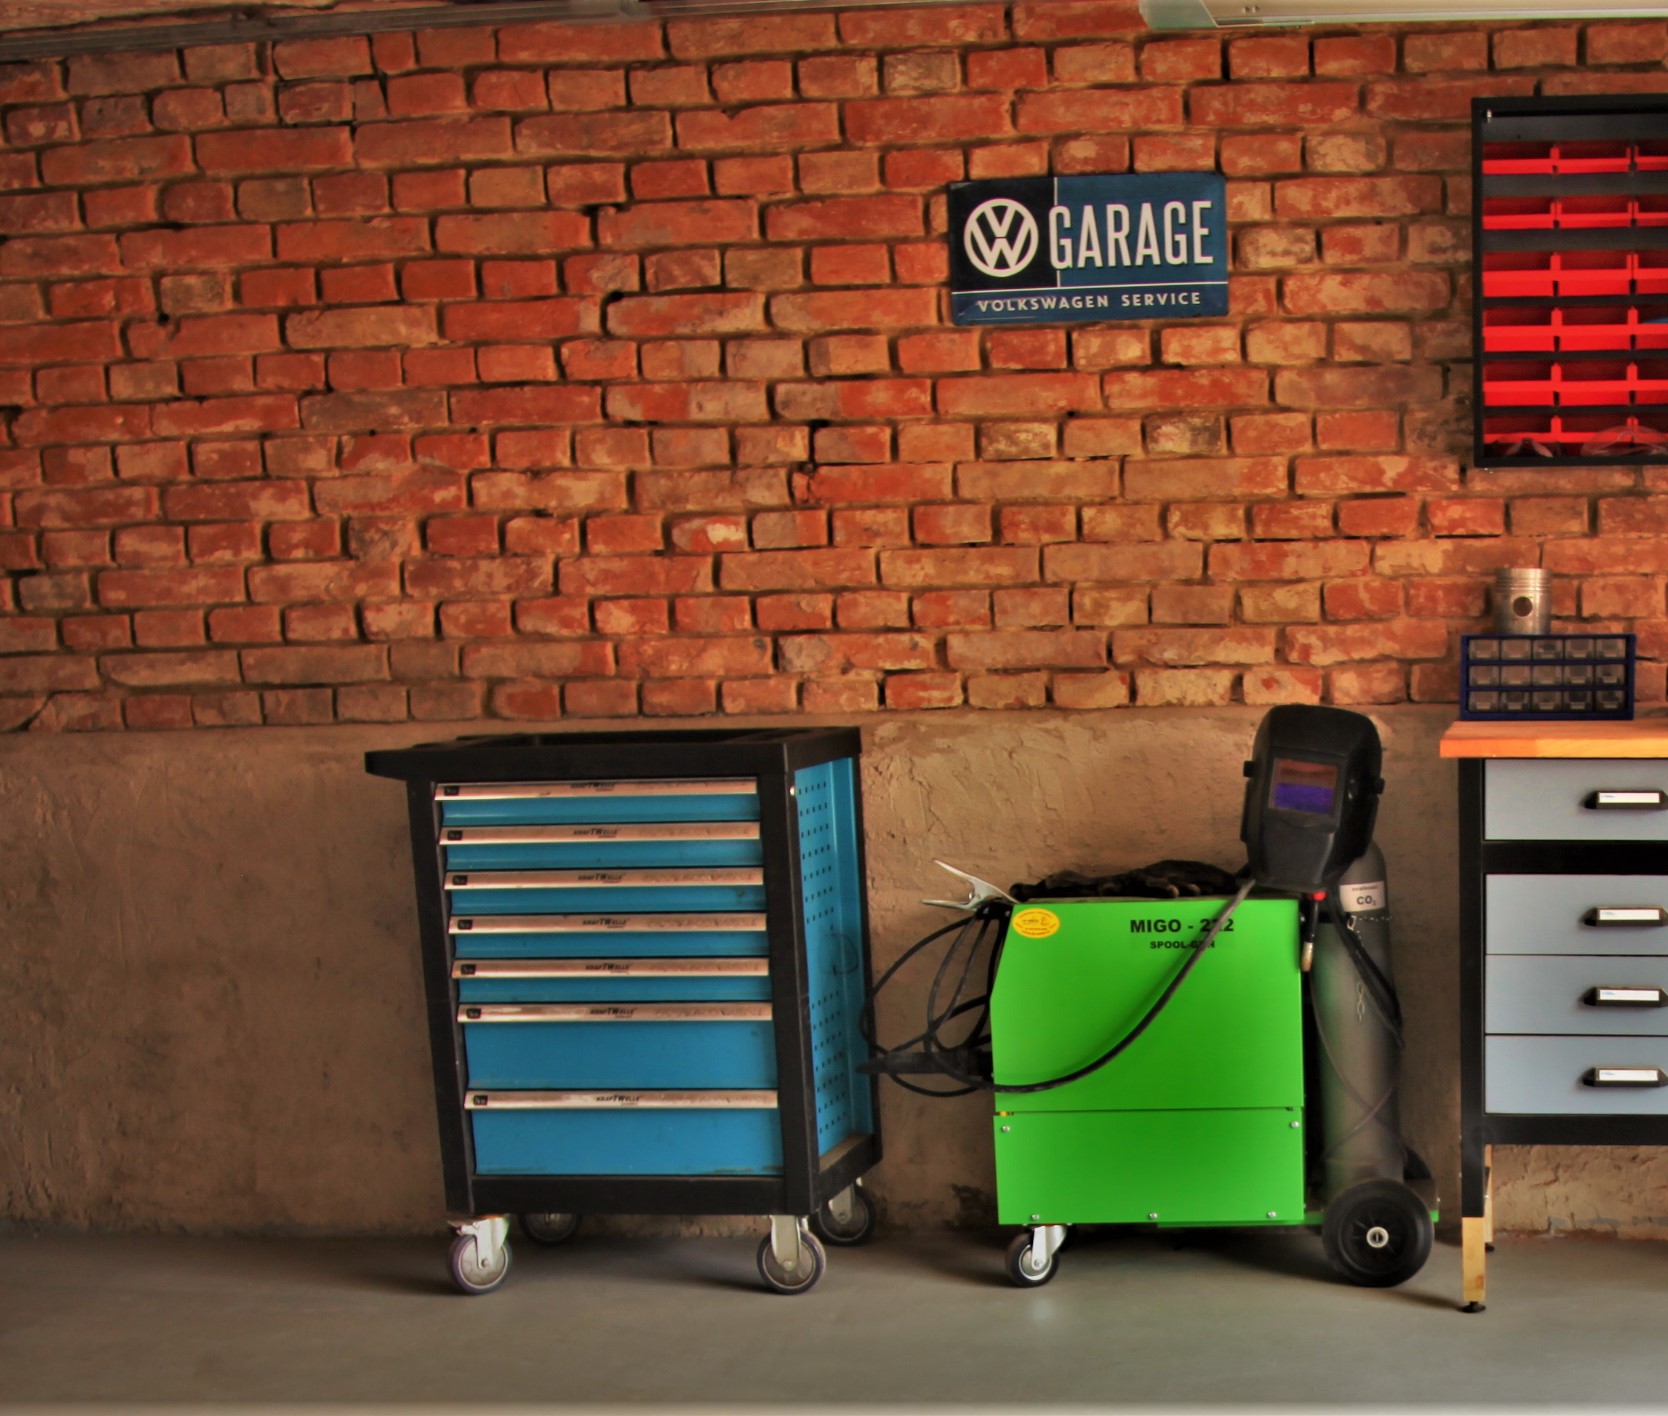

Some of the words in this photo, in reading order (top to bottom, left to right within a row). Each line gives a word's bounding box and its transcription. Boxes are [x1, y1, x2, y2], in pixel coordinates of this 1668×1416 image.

[1048, 200, 1213, 270] GARAGE
[976, 293, 1110, 313] VOLKSWAGEN
[1121, 291, 1202, 307] SERVICE
[1130, 918, 1182, 933] MIGO
